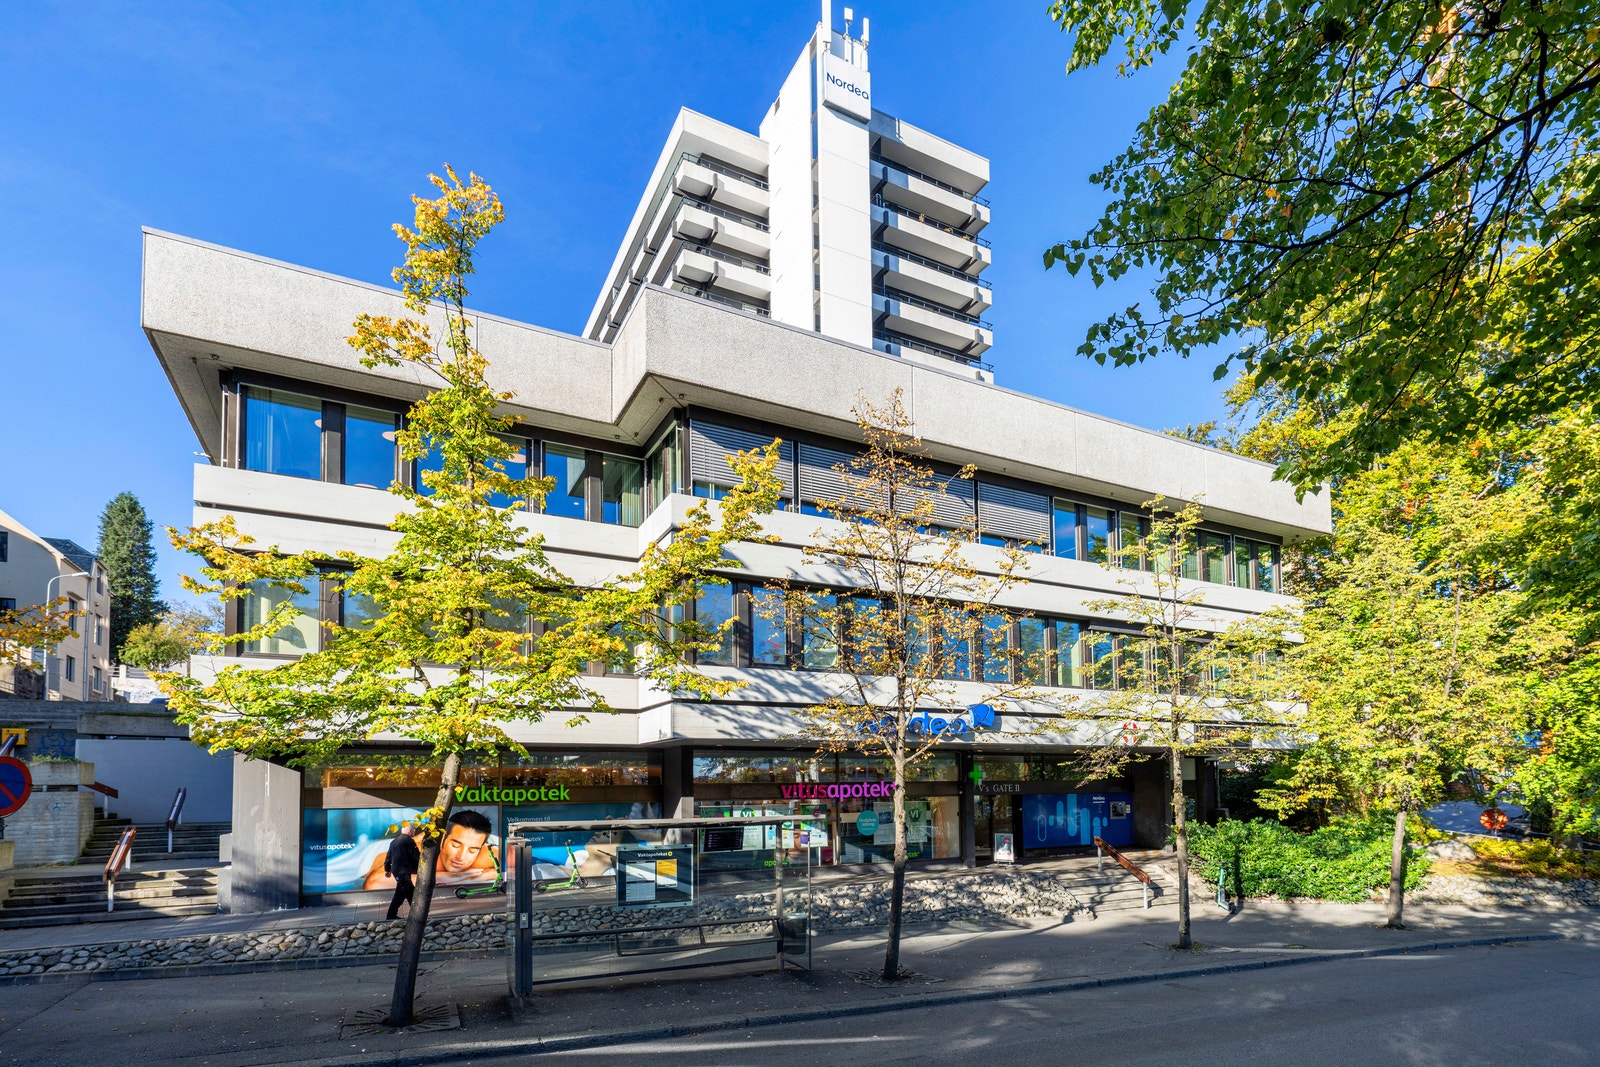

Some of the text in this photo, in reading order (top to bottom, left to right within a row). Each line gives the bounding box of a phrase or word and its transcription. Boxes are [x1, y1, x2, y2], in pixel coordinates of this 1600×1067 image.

[826, 72, 869, 100] Nordea
[856, 709, 968, 735] odea
[455, 784, 570, 806] Vaktapotek
[781, 780, 891, 802] vitusapotek
[992, 784, 1013, 792] GATE
[310, 843, 353, 851] vitusapotek
